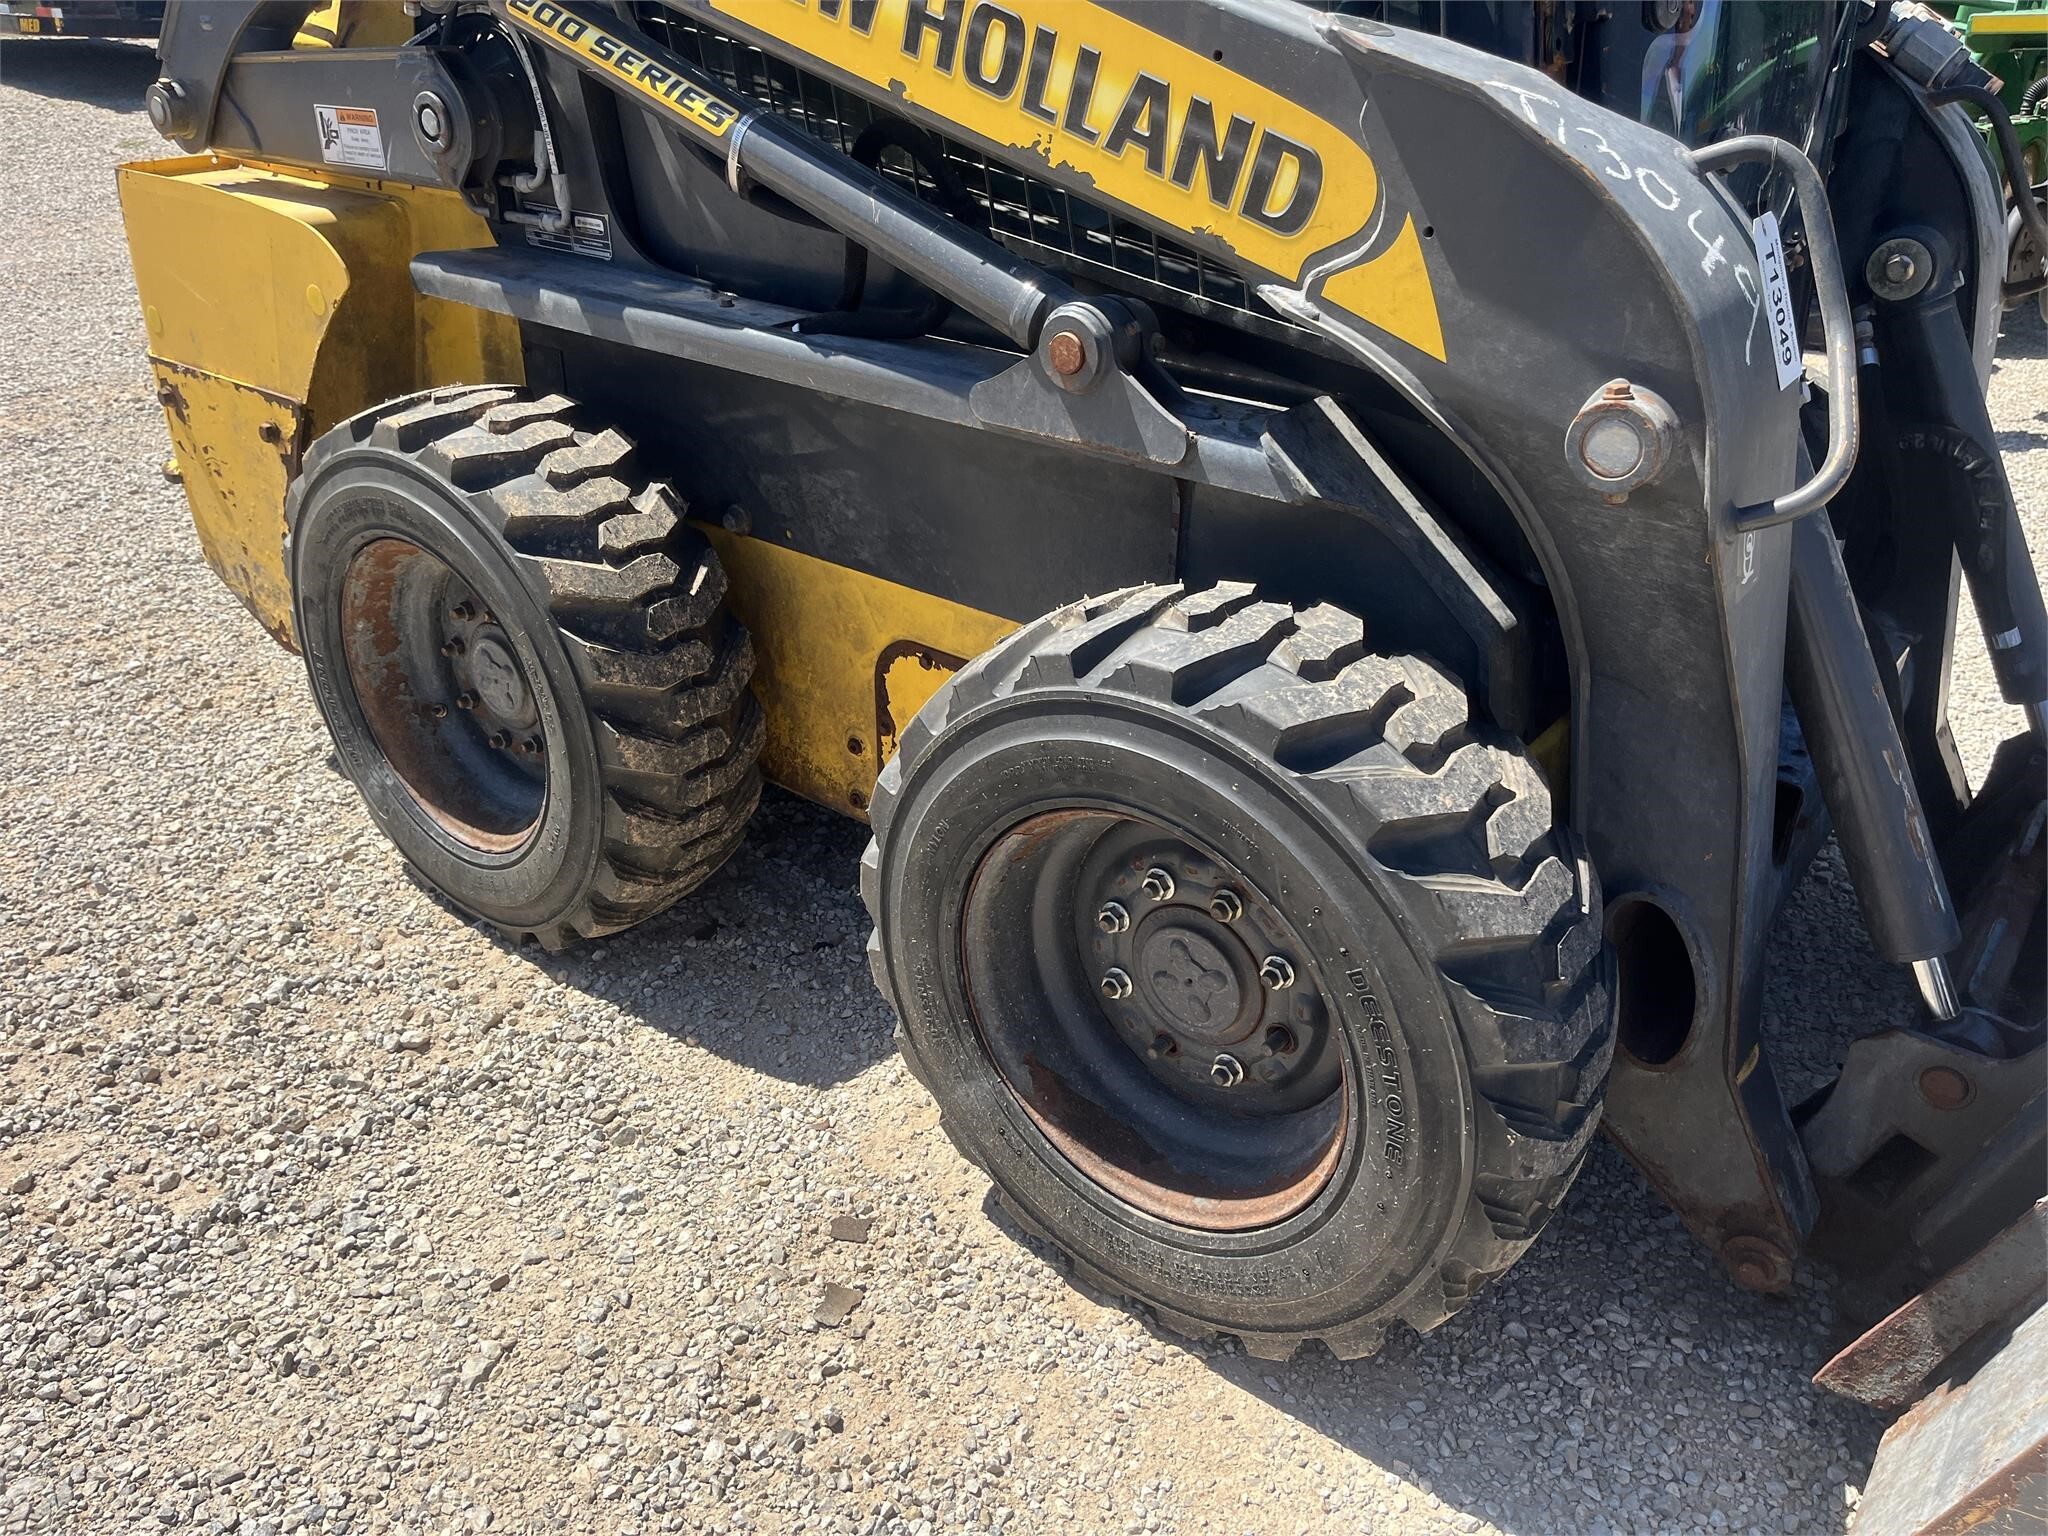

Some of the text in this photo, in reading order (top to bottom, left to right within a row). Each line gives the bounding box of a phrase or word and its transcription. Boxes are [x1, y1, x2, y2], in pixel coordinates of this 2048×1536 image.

[588, 35, 737, 128] SERIES
[899, 0, 1323, 237] HOLLAND
[1765, 242, 1792, 367] T13049
[1345, 967, 1405, 1166] DEESTONE
